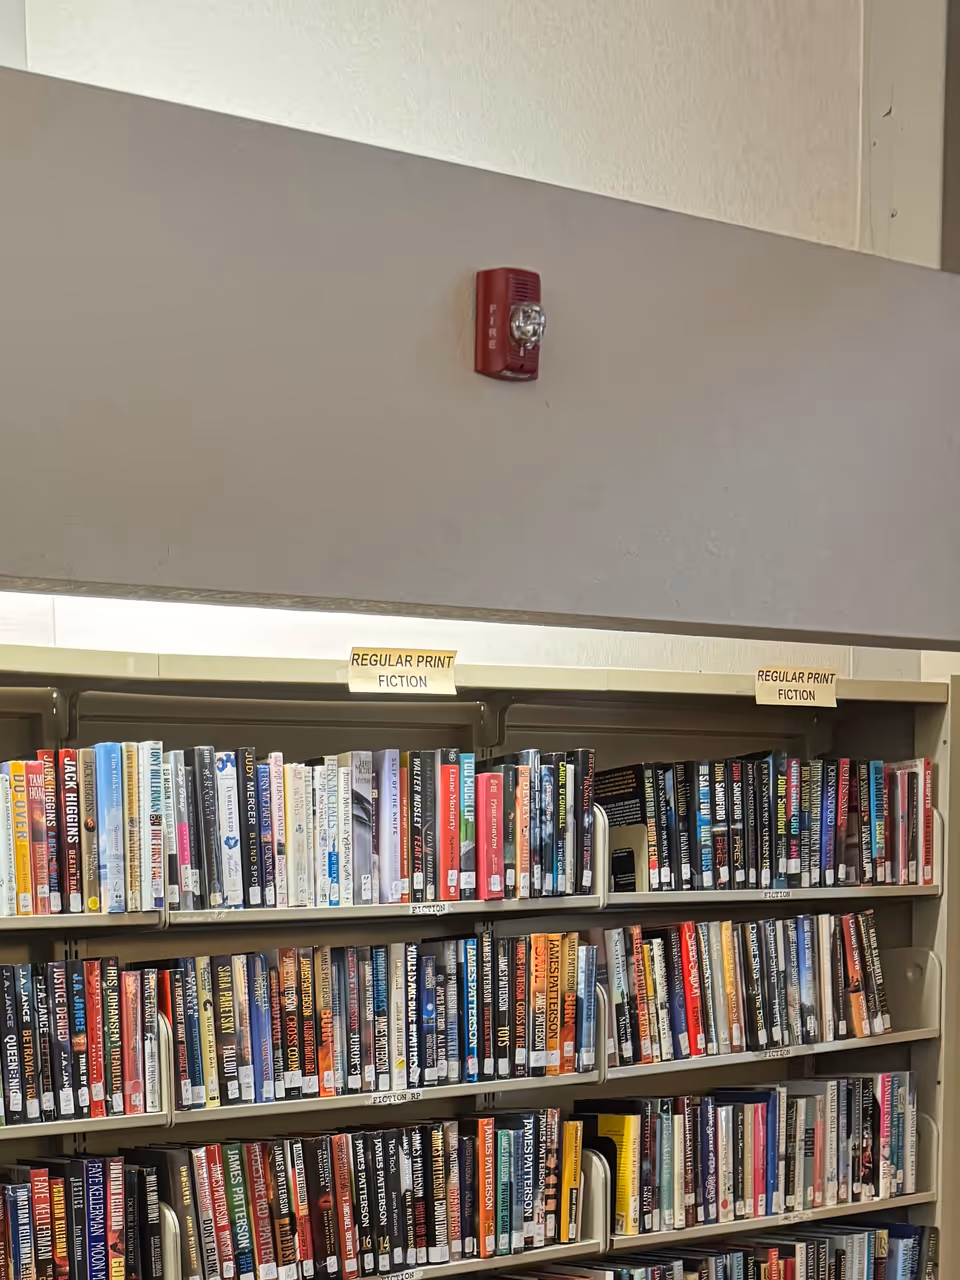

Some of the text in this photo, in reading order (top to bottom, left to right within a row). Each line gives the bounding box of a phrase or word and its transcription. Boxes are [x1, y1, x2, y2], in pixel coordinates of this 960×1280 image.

[488, 303, 497, 349] FIRE
[351, 653, 454, 669] REGULAR PRINT
[378, 676, 427, 688] FICTION
[757, 670, 836, 684] REGULAR PRINT
[778, 689, 816, 701] FICTION
[63, 757, 76, 789] JACK
[246, 752, 256, 824] JUDY MERCER
[412, 758, 422, 829] WALTER MOSLEY
[65, 793, 79, 843] HIGGINS
[447, 769, 457, 831] Liane Moriarty
[778, 775, 787, 834] John Sandford
[411, 904, 445, 914] FICTION
[763, 890, 791, 899] FICTION
[53, 968, 68, 1041] JUSTICE DENIED
[107, 966, 119, 1041] IRIS JOHANSEN
[217, 966, 234, 1034] SARA PARETSKY
[373, 1092, 421, 1104] FICTION RP
[33, 1176, 51, 1259] FAYE KELLERMAN
[227, 1149, 250, 1248] JAMES PATTERSON
[202, 1219, 219, 1275] DON'T BLINK
